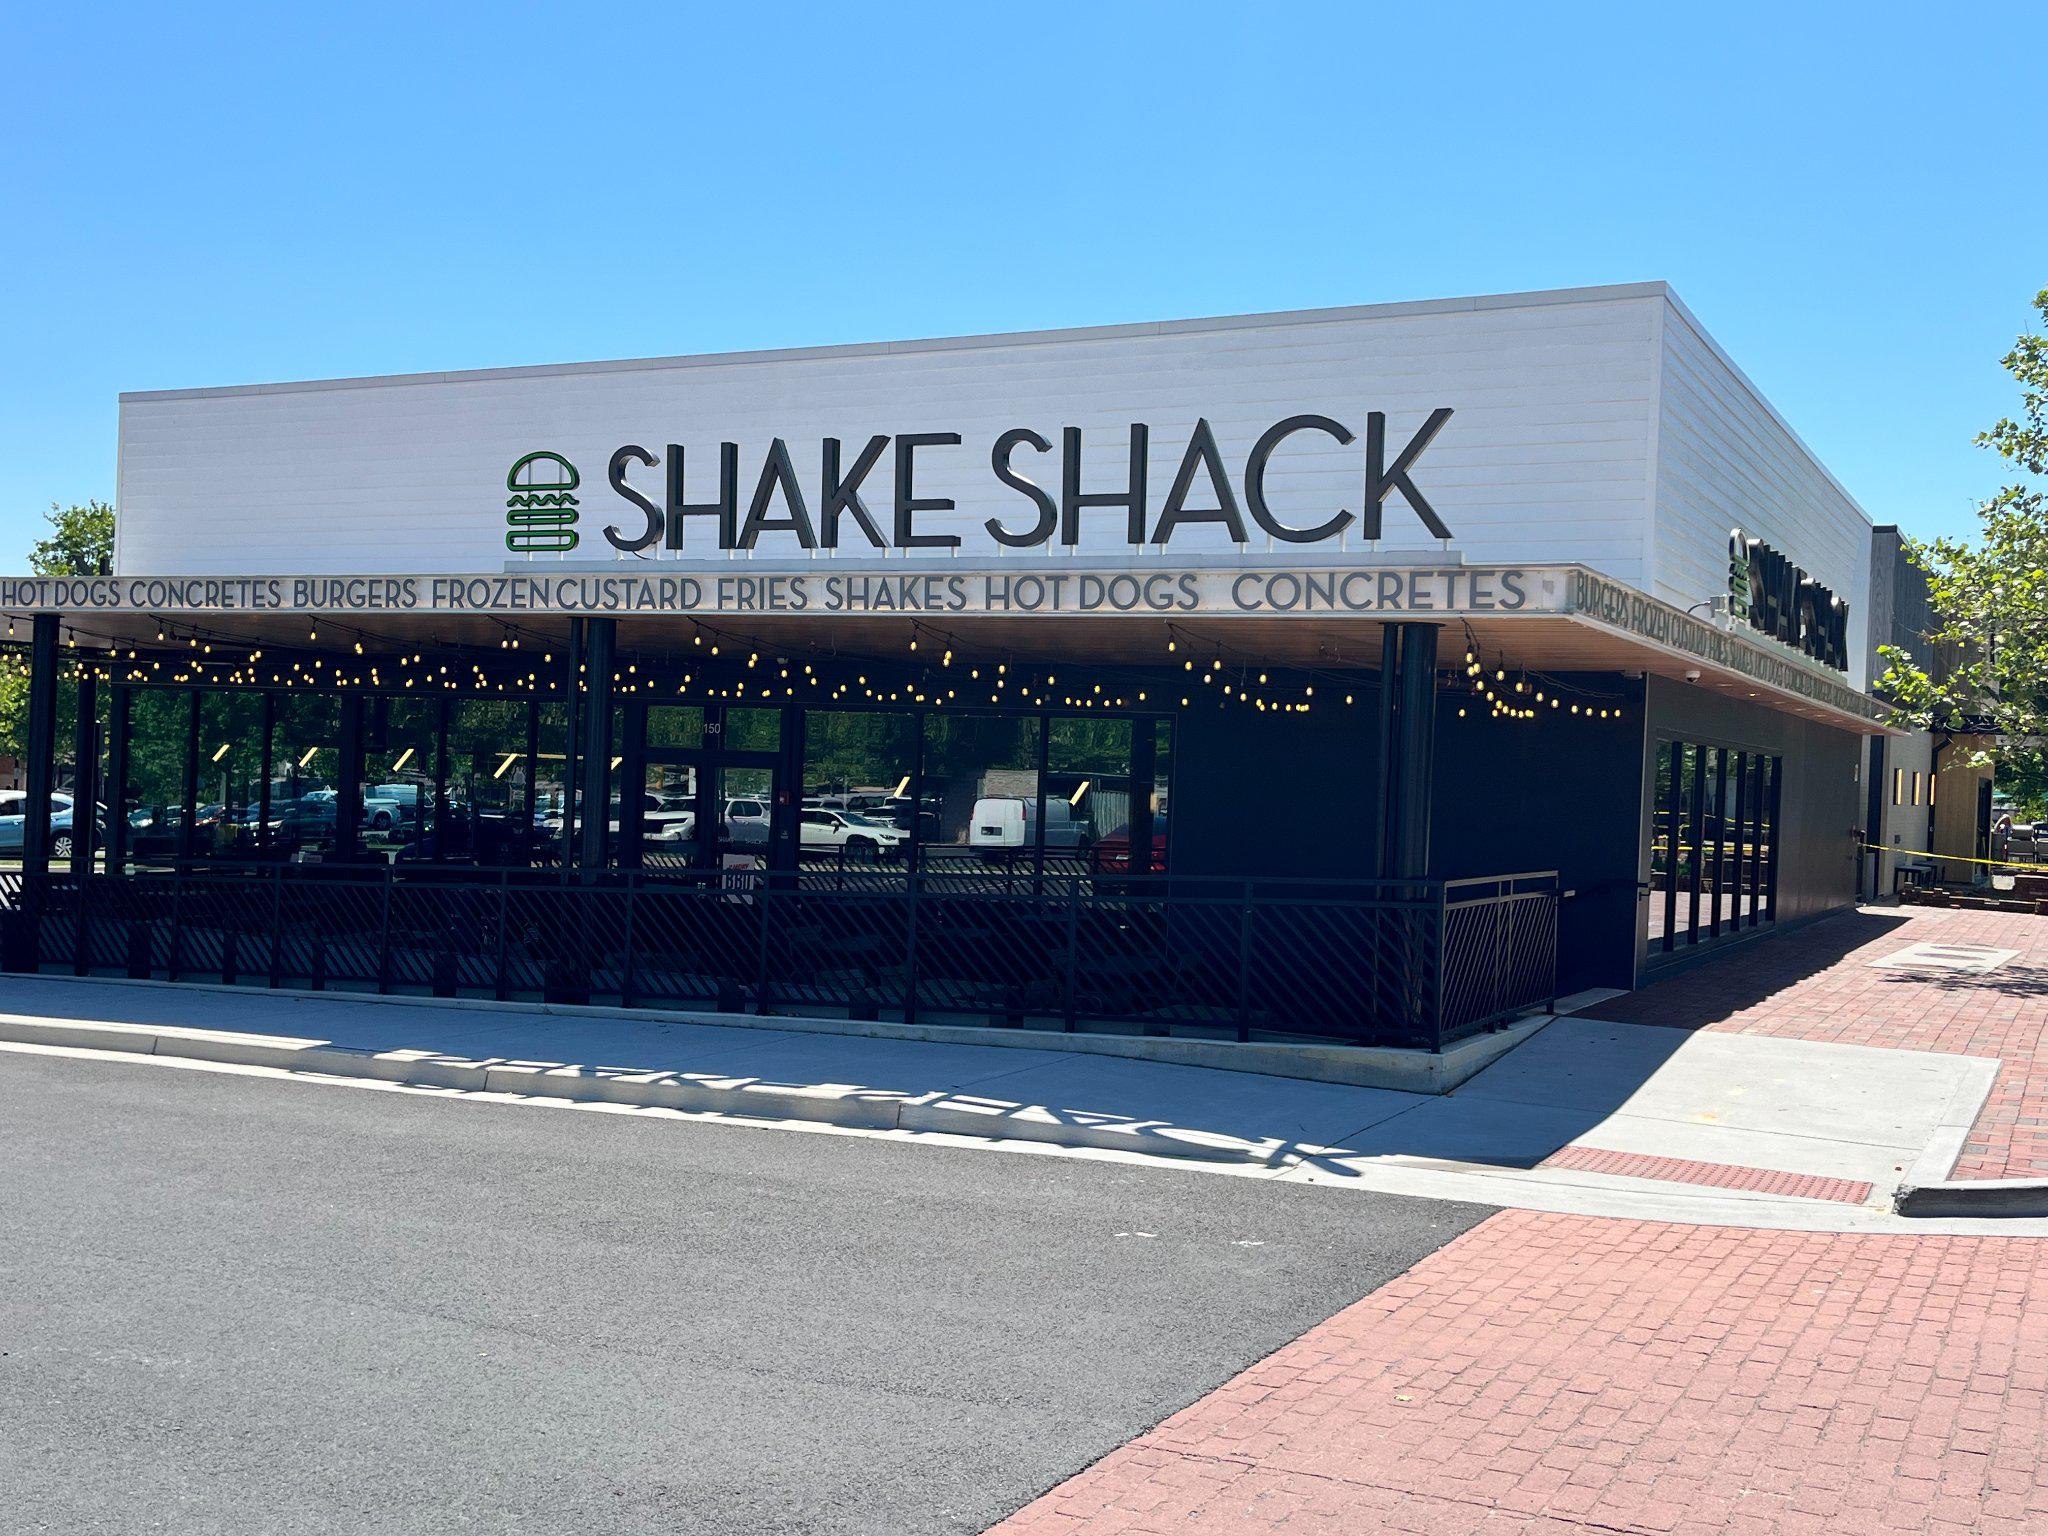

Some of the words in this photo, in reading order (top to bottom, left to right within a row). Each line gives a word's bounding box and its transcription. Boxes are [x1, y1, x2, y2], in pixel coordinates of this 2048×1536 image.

[603, 433, 962, 551] SHAKE
[984, 408, 1454, 547] SHACK
[2, 580, 50, 606] HOT
[55, 580, 121, 607] DOGS
[129, 580, 282, 608] CONCRETES
[293, 579, 417, 608] BURGERS
[432, 578, 549, 609] FROZEN
[556, 578, 702, 610] CUSTARD
[717, 577, 808, 610] FRIES
[825, 576, 966, 610] SHAKES
[985, 575, 1069, 610] HOT
[1079, 574, 1200, 610] DOGS
[1231, 570, 1526, 610] CONCRETES
[1576, 571, 1629, 628] BURGERS
[703, 723, 721, 734] 150
